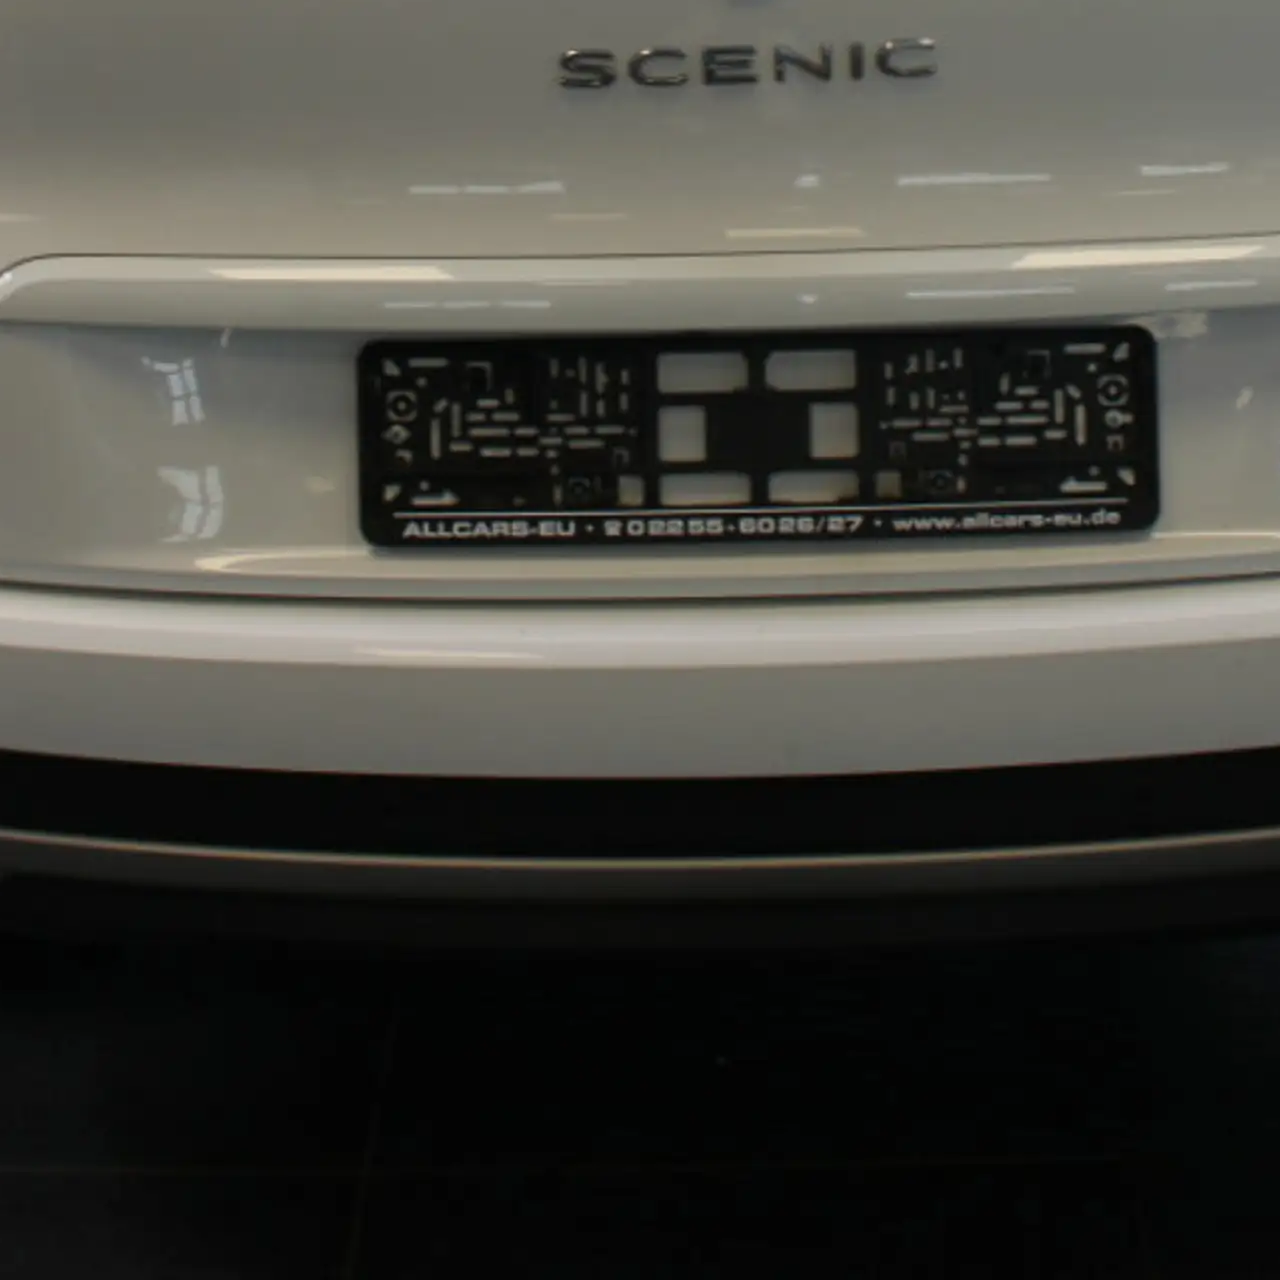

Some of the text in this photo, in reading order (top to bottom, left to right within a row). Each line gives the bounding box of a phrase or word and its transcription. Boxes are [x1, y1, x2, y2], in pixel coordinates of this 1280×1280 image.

[559, 37, 937, 88] SCENIC
[402, 520, 576, 539] ALLCARS-EU
[892, 508, 1121, 531] www.allcars-eu.de
